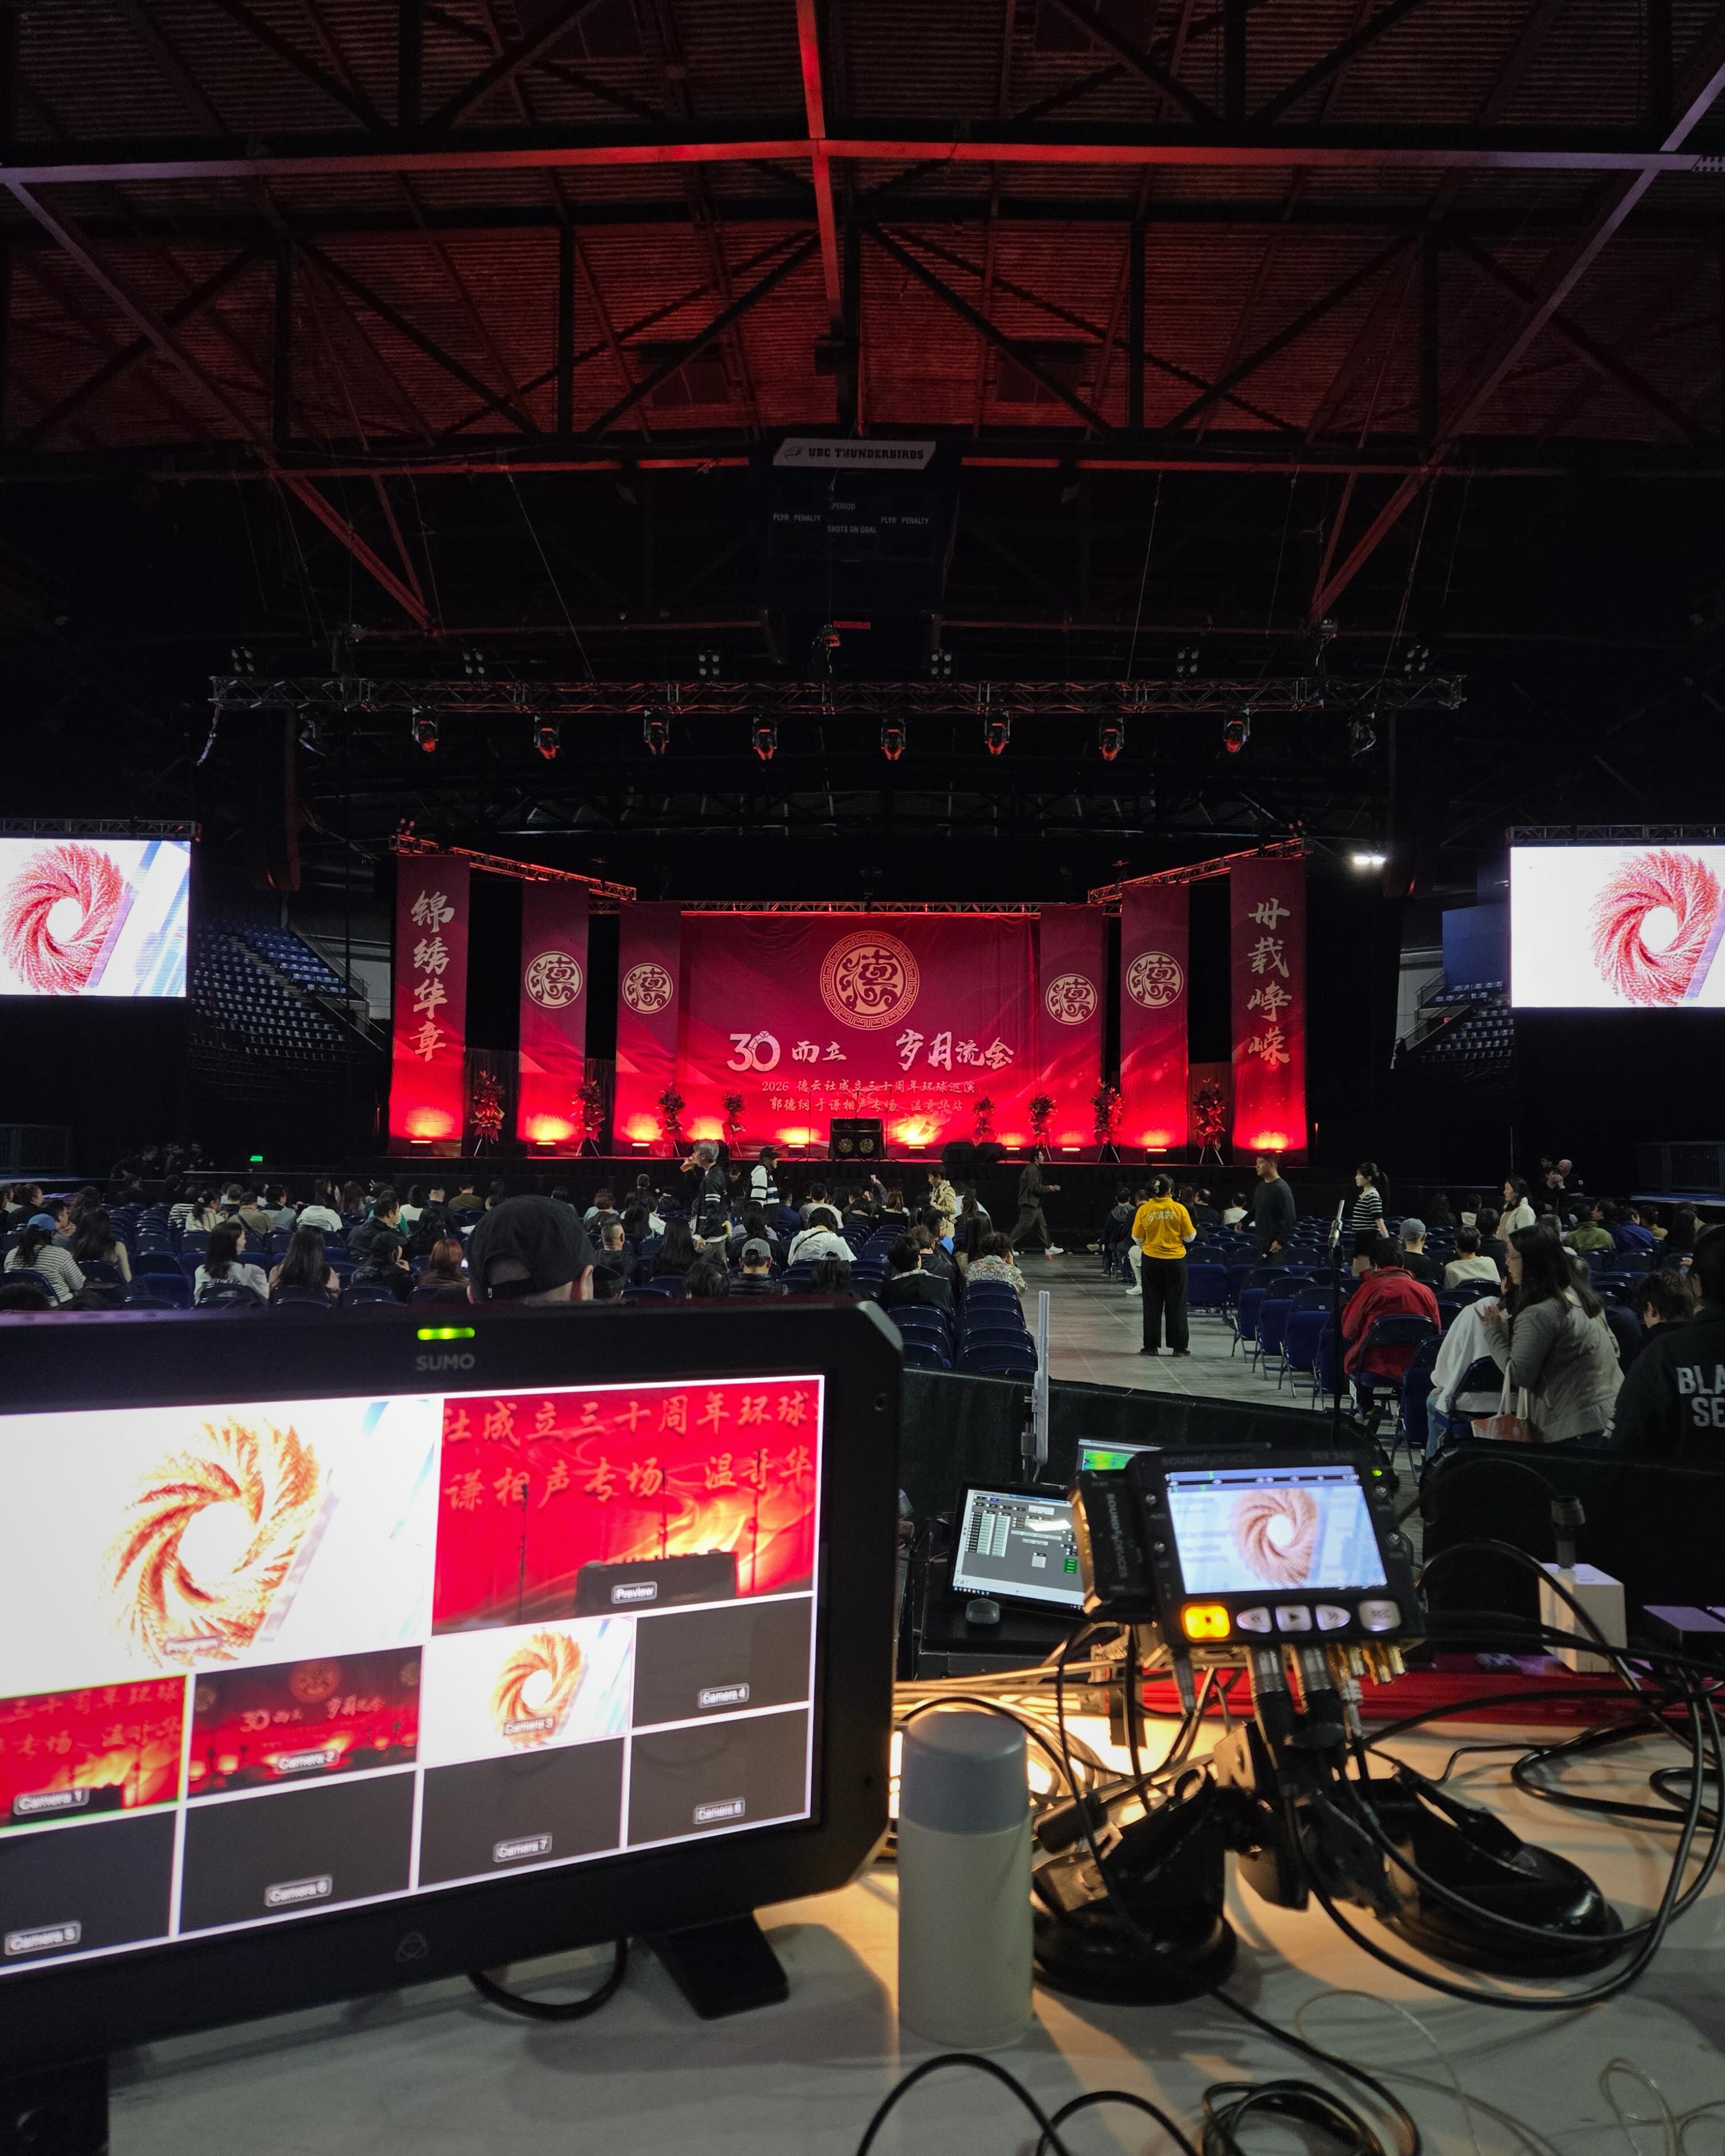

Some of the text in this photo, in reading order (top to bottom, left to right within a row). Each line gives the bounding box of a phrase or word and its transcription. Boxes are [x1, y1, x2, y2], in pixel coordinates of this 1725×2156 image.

[808, 448, 924, 459] UBC THUNDERBIRDS
[793, 514, 822, 522] PENALTY
[902, 516, 929, 525] PENALTY
[827, 525, 848, 534] SHOTS
[410, 889, 455, 1062] 锦绣华章
[727, 1029, 1014, 1071] 30 而立 岁月流金
[762, 1081, 789, 1092] 2026
[415, 1353, 476, 1371] SUMO
[442, 1390, 819, 1447] 社成立三十周年环球
[616, 1587, 654, 1599] Preview
